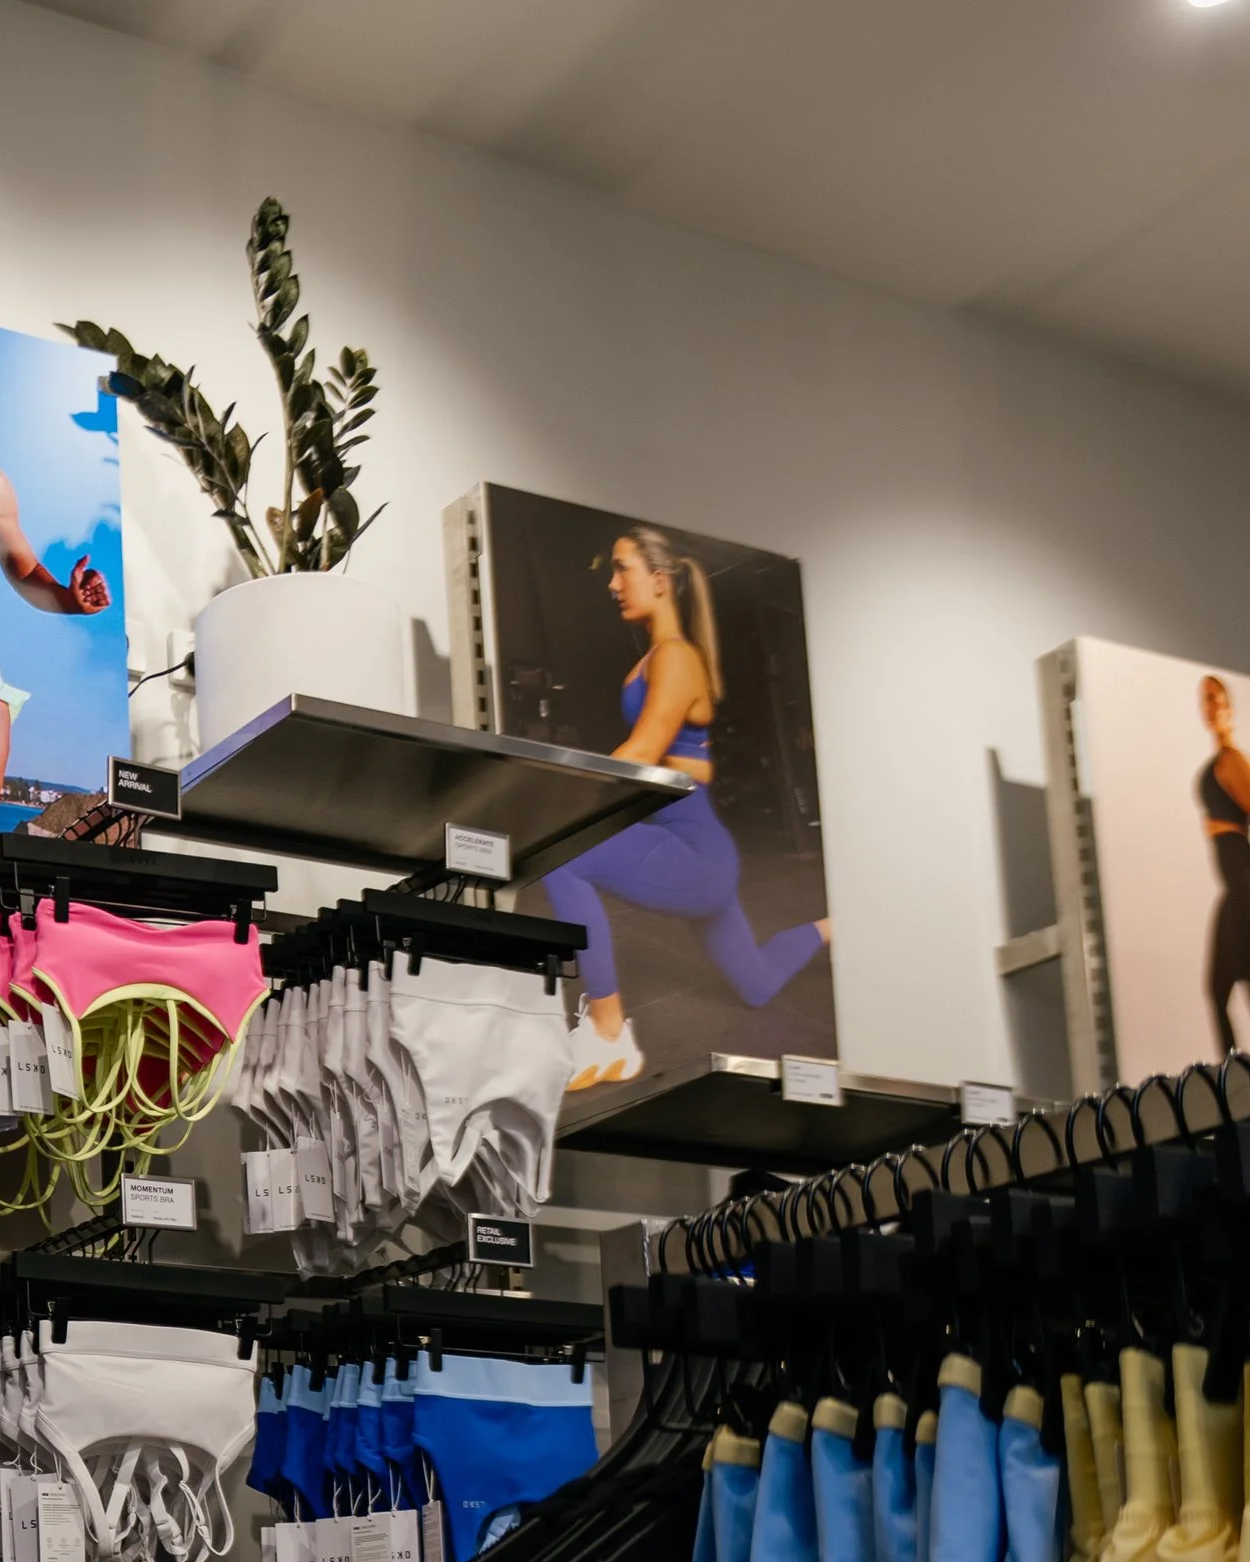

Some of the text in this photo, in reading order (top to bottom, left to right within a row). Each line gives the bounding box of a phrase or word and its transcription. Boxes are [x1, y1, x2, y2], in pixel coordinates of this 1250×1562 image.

[118, 769, 139, 781] NEW
[117, 778, 154, 794] ARRIVAL
[17, 1062, 46, 1074] LSKD
[130, 1184, 174, 1195] MOMENTUM
[255, 1188, 269, 1197] LS
[130, 1193, 174, 1204] SPORTS BRA
[476, 1226, 502, 1236] RETAIL
[476, 1234, 518, 1246] EXCLUSIVE
[21, 1519, 37, 1530] LS
